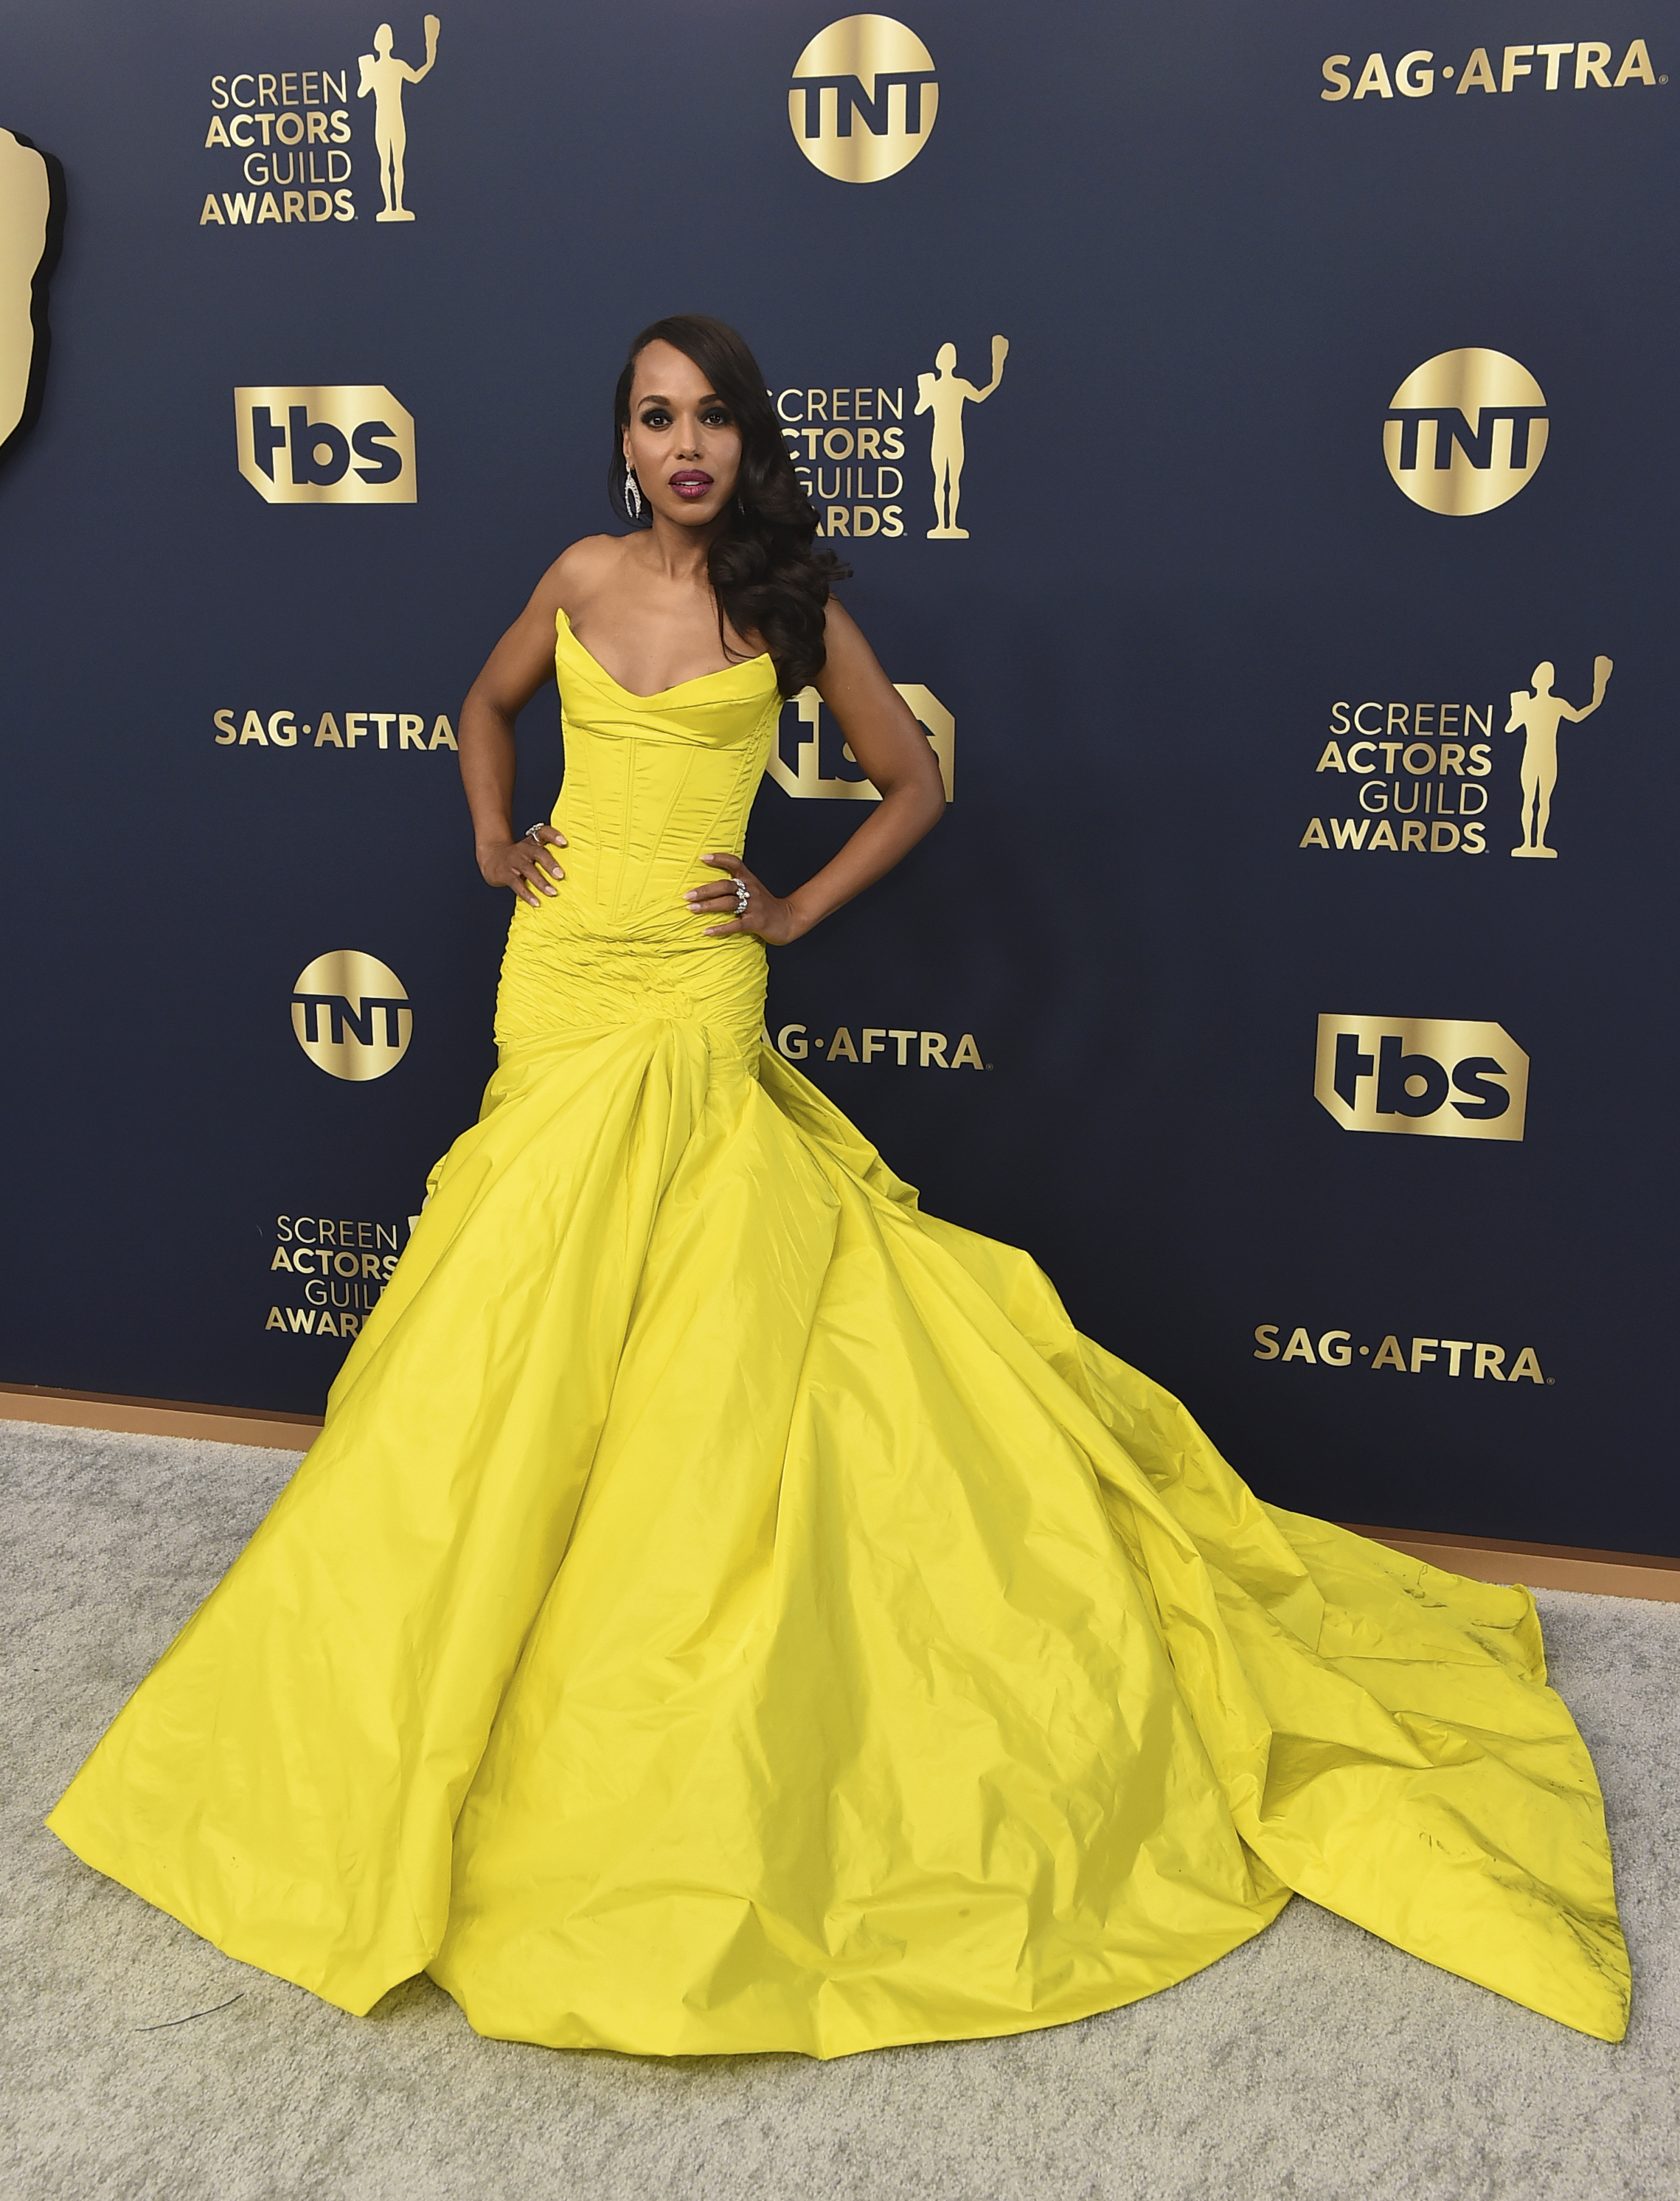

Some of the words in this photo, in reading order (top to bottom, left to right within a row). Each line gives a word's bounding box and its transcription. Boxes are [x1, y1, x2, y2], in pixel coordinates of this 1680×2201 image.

[211, 72, 347, 110] SCREEN
[788, 69, 939, 139] TNT
[204, 111, 352, 148] ACTORS
[243, 150, 352, 186] GUILD
[200, 189, 355, 225] AWARDS
[767, 388, 903, 422] CREEN
[251, 406, 403, 487] tbs
[1384, 405, 1550, 471] TNT
[816, 505, 904, 538] RDS
[1329, 701, 1493, 737] SCREEN
[1316, 741, 1492, 777] ACTORS
[1358, 780, 1488, 815] GUILD
[1299, 817, 1486, 854] AWARDS
[291, 994, 412, 1048] TNT
[1333, 1033, 1511, 1120] tbs
[277, 1215, 398, 1250] SCREEN
[271, 1246, 398, 1280] ACTORS
[305, 1279, 386, 1310] GUIL
[265, 1306, 370, 1338] AWAR
